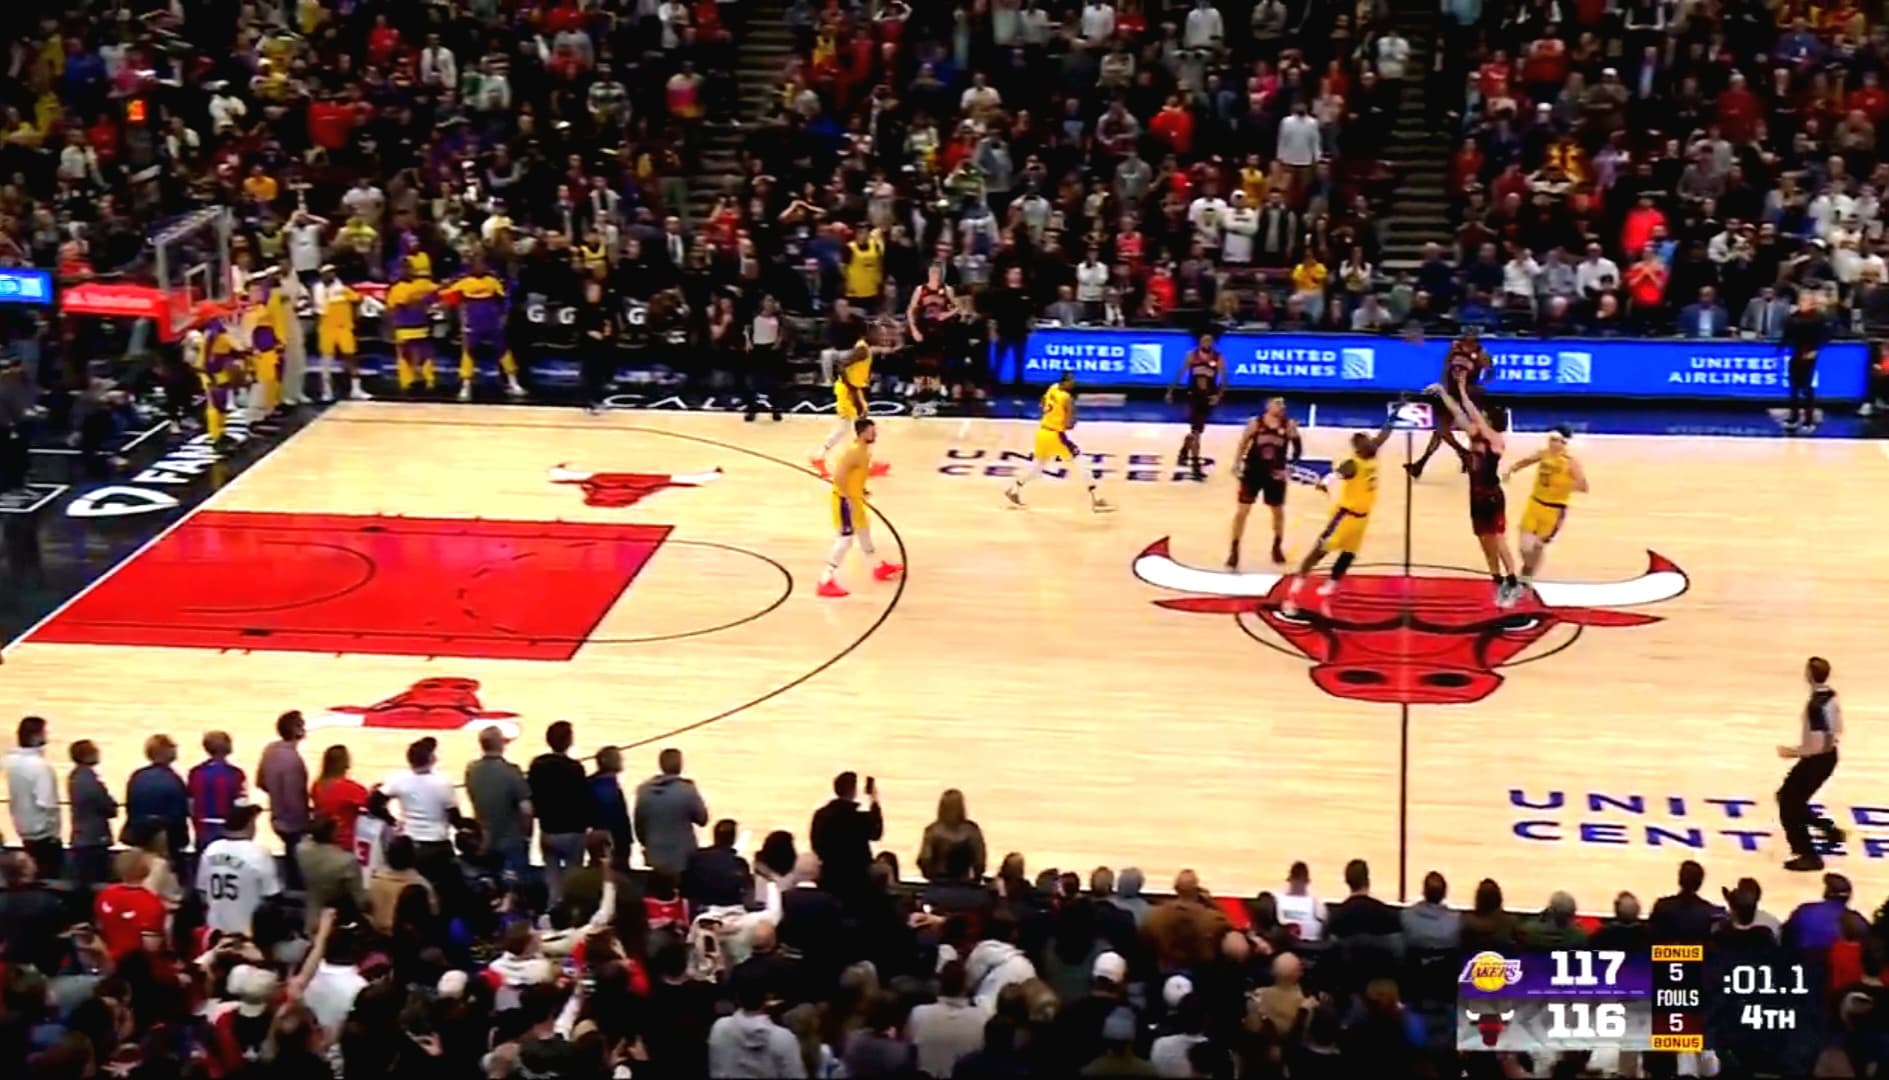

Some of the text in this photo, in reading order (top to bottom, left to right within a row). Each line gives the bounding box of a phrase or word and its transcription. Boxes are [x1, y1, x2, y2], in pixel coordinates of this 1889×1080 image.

[1045, 343, 1125, 357] UNITED
[1255, 348, 1336, 362] UNITED
[1026, 357, 1126, 372] AIRLINES
[1235, 362, 1337, 377] AIRLINES
[1690, 357, 1777, 370] UNITED
[1668, 371, 1778, 385] AIRLINES
[946, 449, 1215, 467] UNTED
[210, 873, 239, 901] 05
